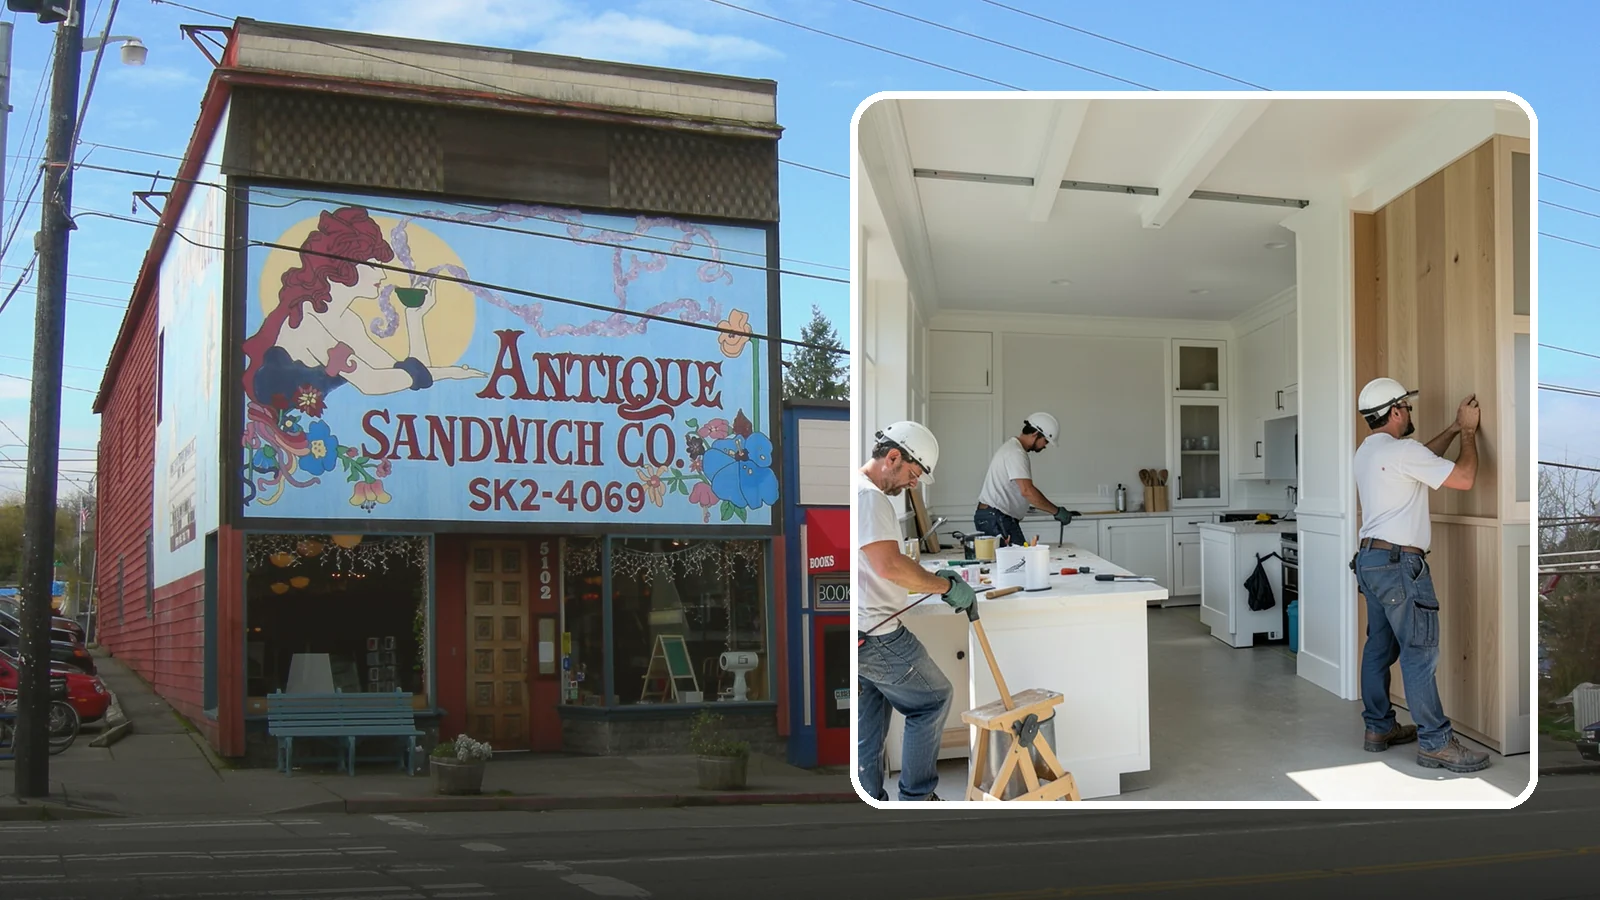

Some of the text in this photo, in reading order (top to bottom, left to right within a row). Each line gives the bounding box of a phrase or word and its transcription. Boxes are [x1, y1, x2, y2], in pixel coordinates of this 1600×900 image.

[475, 328, 724, 421] ANTIQUE
[361, 408, 685, 469] SANDWICH CO.
[468, 476, 646, 513] SK2-4069
[539, 541, 552, 600] 5102
[809, 554, 835, 569] BOOKS
